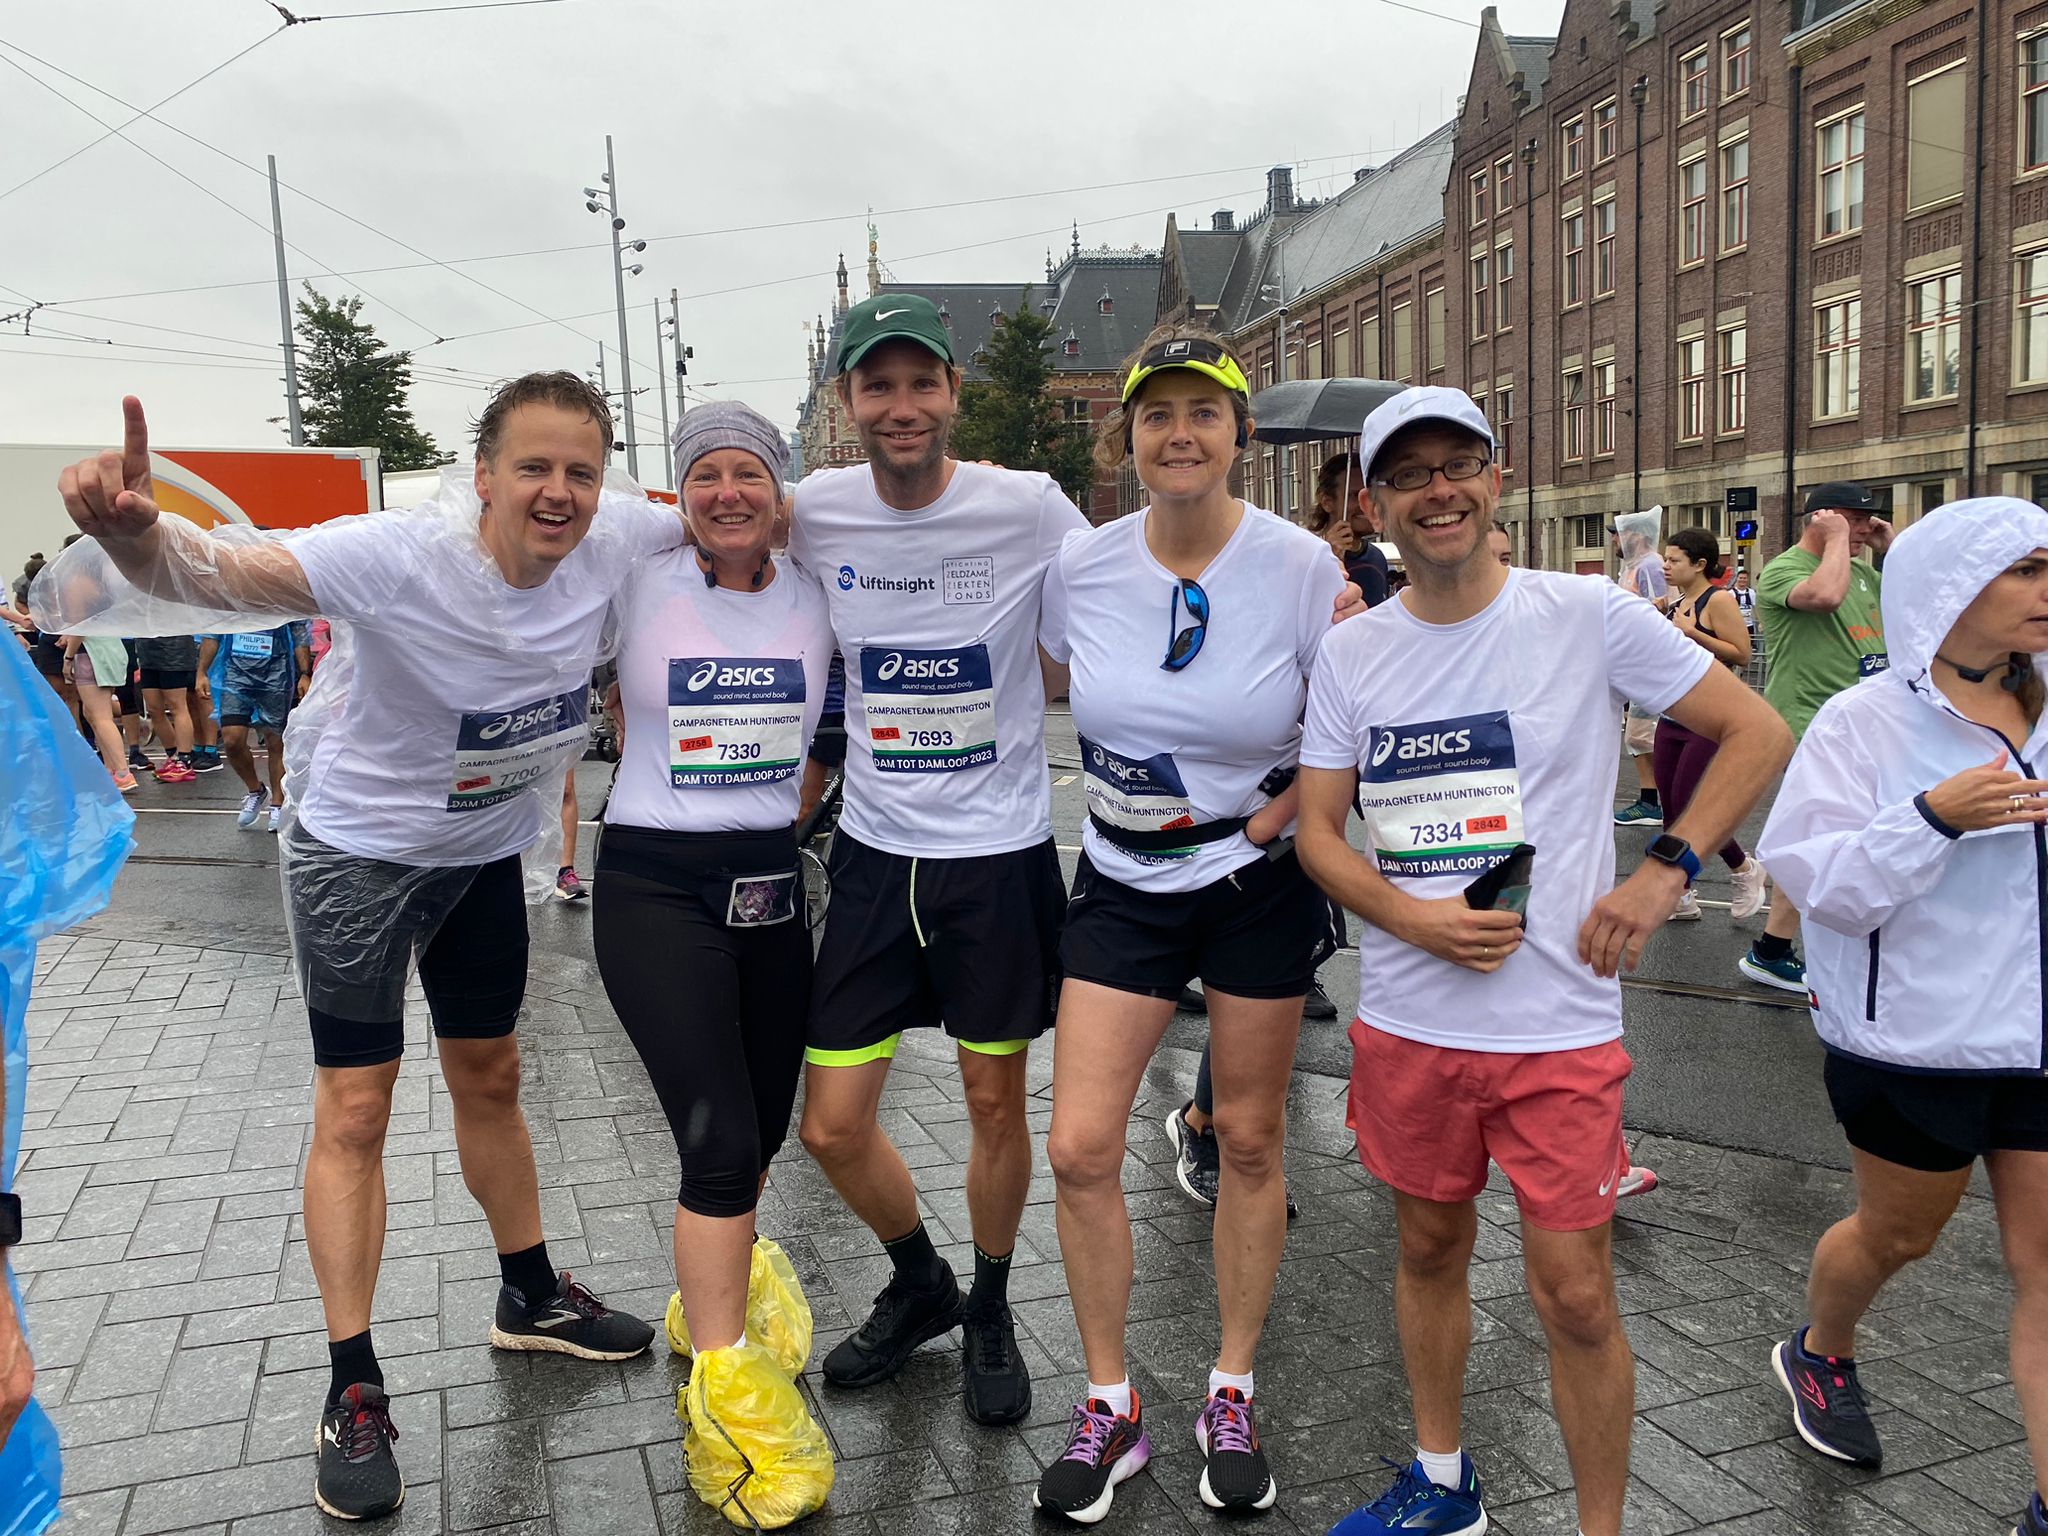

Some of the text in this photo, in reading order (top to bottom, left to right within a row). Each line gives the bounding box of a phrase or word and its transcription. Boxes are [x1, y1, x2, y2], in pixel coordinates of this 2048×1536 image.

[946, 569, 989, 579] ZELDZAME
[859, 576, 935, 594] Liftinsight
[947, 580, 990, 589] ZIEKTEN
[947, 591, 991, 600] FONDS
[240, 635, 265, 644] PHILIPS
[717, 667, 775, 687] asics
[903, 658, 960, 678] asics
[937, 681, 956, 690] sound
[957, 680, 974, 688] body
[713, 692, 733, 700] sound
[752, 691, 771, 699] sound
[772, 691, 788, 700] body
[510, 701, 563, 733] asics
[867, 701, 991, 715] CAMPAGNETEAM HUNTINGTON
[673, 715, 801, 728] CAMPAGNETEAM HUNTINGTON
[908, 730, 953, 747] 7693
[1397, 729, 1471, 760] asics
[717, 743, 761, 761] 7330
[873, 750, 992, 769] DAM TOT DAMLOOP 2023
[1107, 756, 1150, 782] asics
[1396, 765, 1420, 775] sound
[1444, 758, 1469, 768] sound
[1470, 757, 1491, 766] body
[501, 765, 540, 786] 7700
[675, 774, 700, 785] DAM
[702, 774, 723, 784] TOT
[725, 770, 774, 783] DAMLOOP
[820, 774, 840, 803] ESPRIT
[1361, 785, 1515, 809] CAMPAGNETEAM HUNTINGTON
[452, 796, 500, 808] DAM TOT
[1132, 807, 1190, 817] HUNTINGTON
[1409, 818, 1500, 845] 7334 2842
[1381, 859, 1401, 872] DAM
[1400, 861, 1419, 874] TOT
[1421, 856, 1486, 873] DAMLOOP
